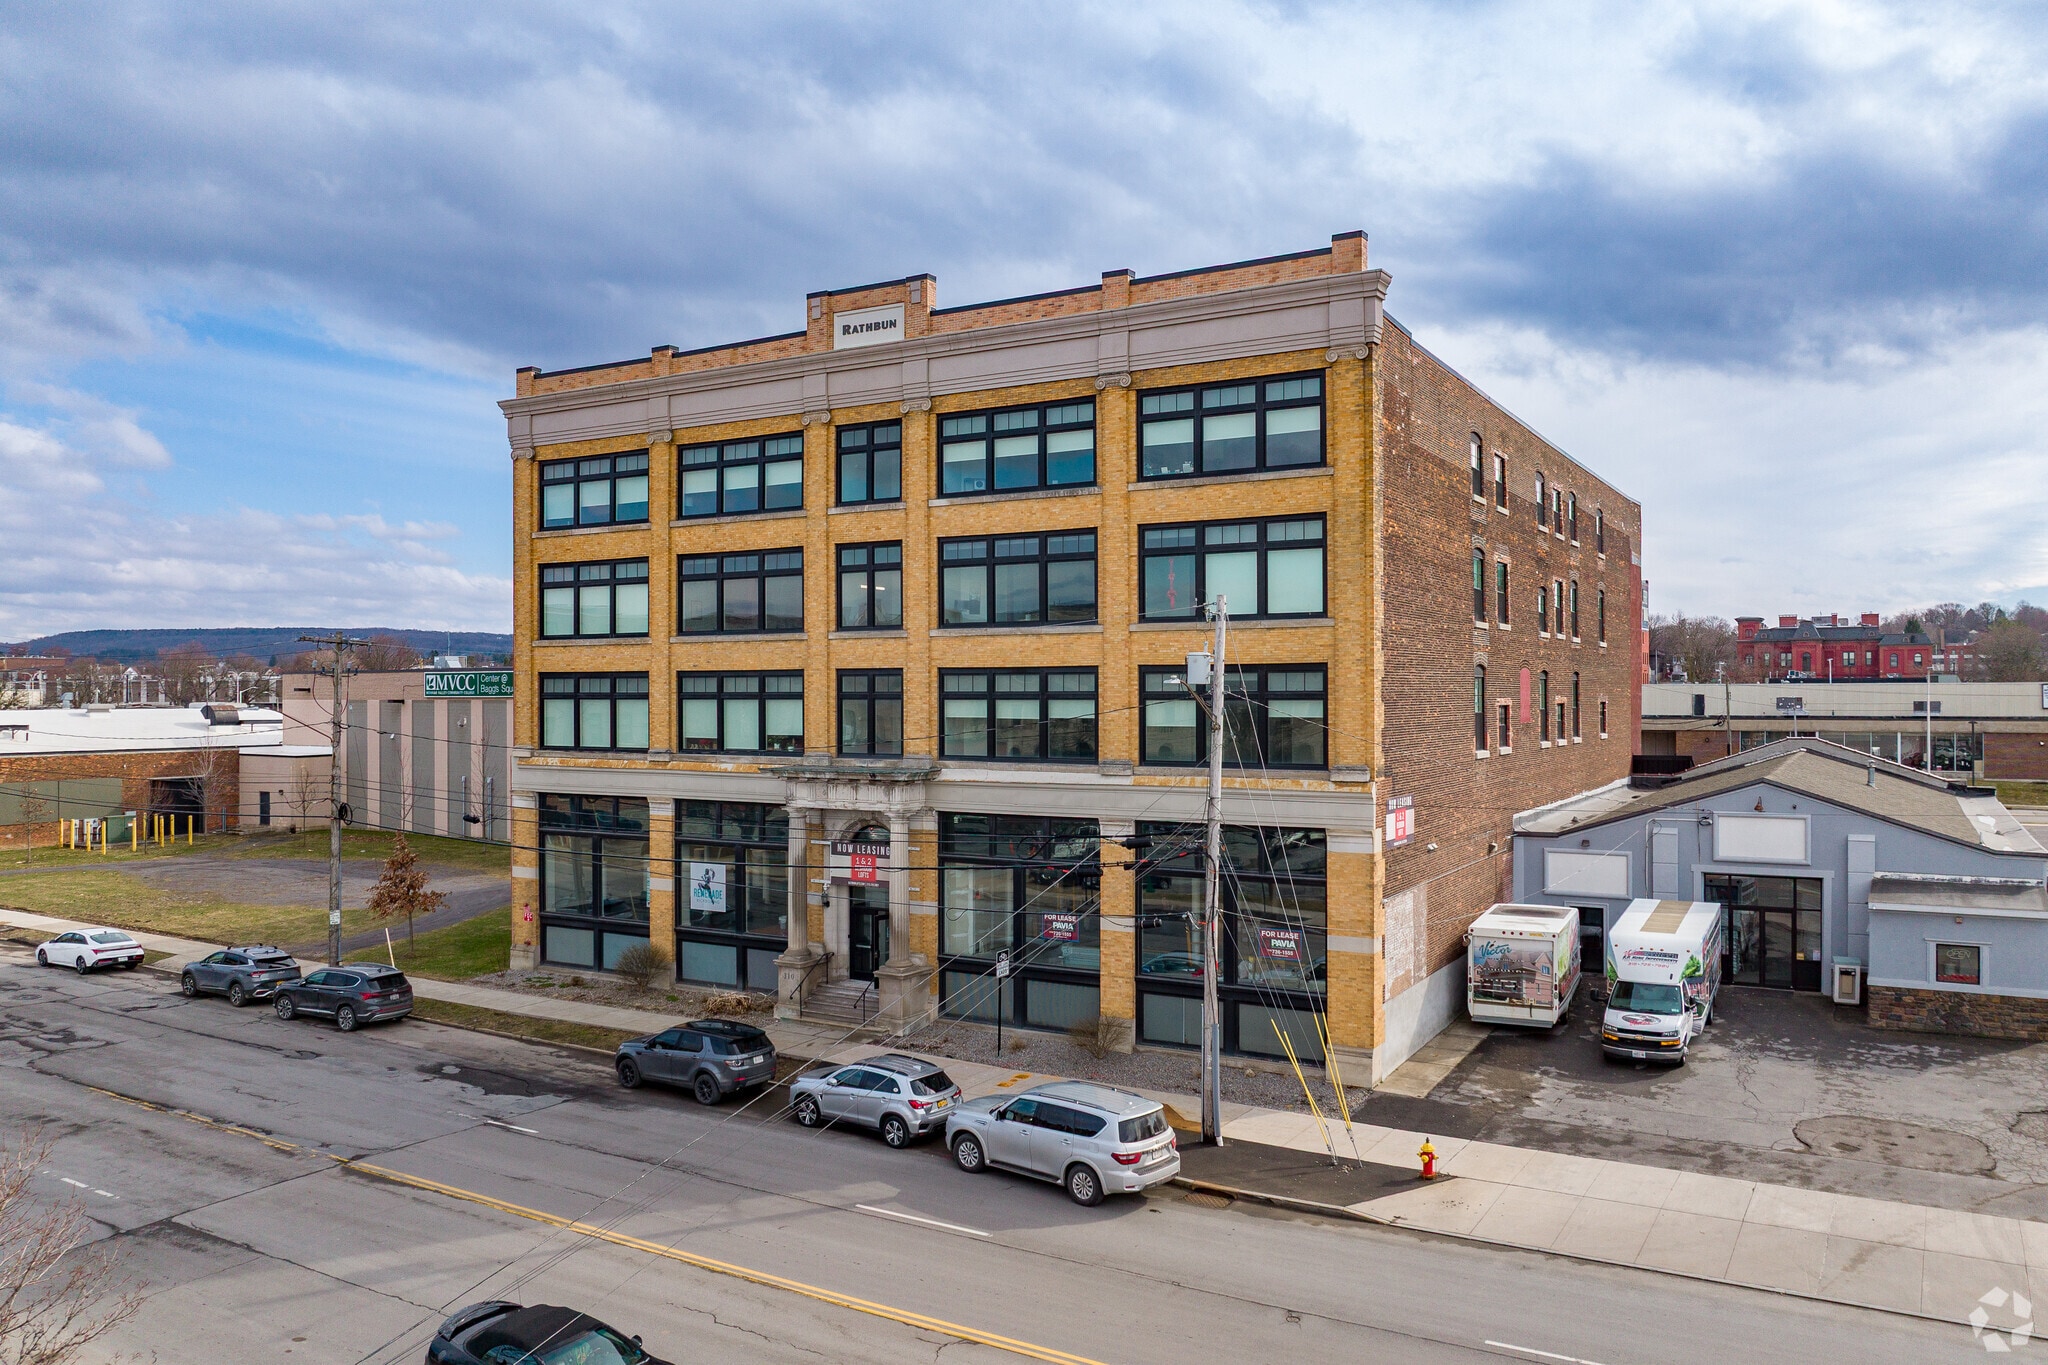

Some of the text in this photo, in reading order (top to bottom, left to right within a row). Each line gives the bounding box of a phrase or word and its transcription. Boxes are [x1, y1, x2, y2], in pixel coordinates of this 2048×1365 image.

[842, 319, 897, 336] RATHBUN
[436, 674, 476, 691] MVCC
[480, 673, 508, 684] Center @
[837, 843, 890, 856] NOW LEASING
[861, 857, 866, 865] &
[1052, 921, 1074, 930] PAVIA
[1261, 930, 1300, 940] FOR LEASE
[1271, 939, 1296, 949] PAVIA
